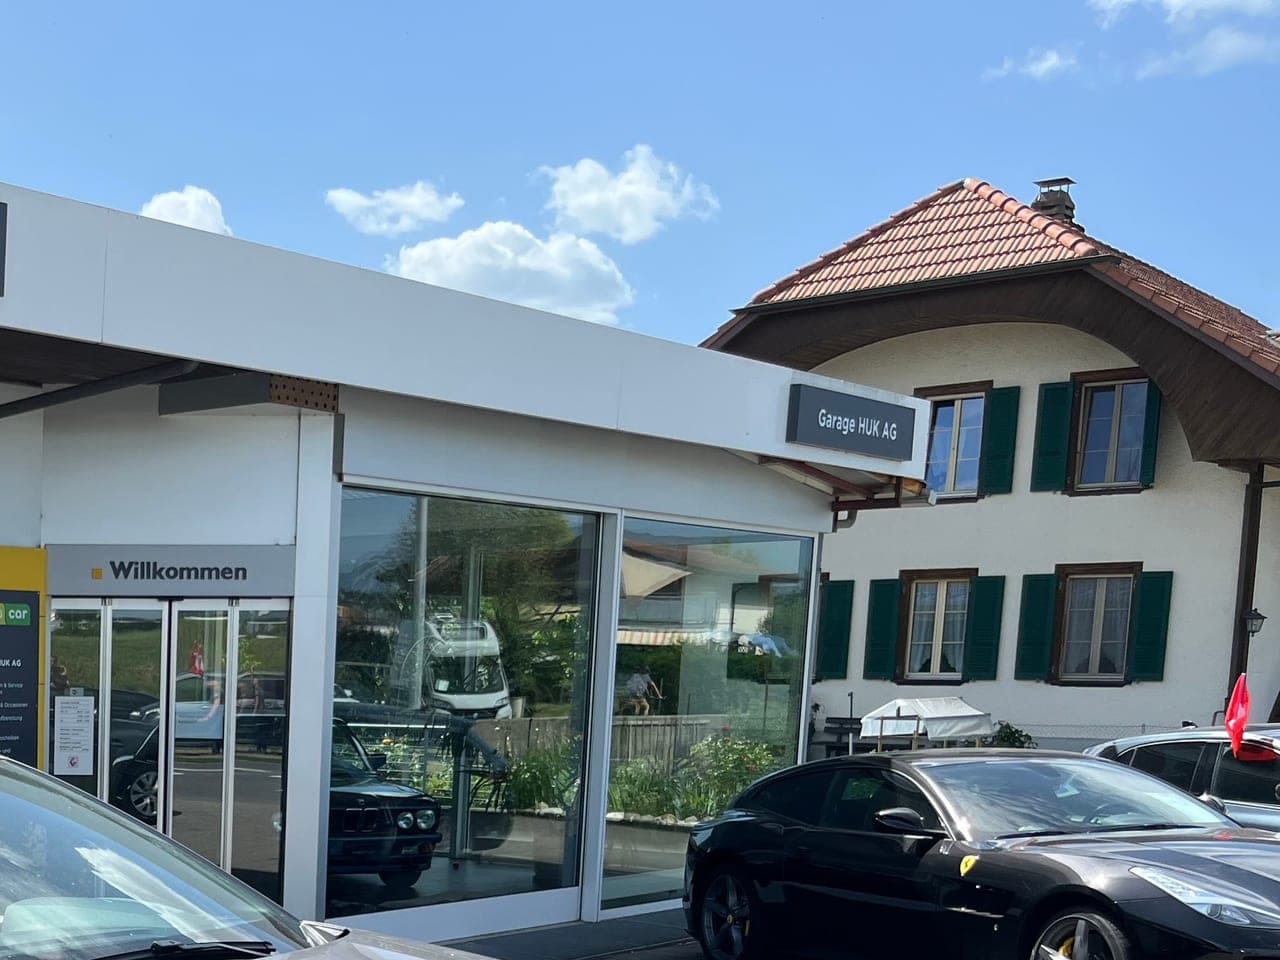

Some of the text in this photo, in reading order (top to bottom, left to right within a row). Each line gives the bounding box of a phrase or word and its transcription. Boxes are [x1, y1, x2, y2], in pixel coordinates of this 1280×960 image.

[818, 408, 897, 441] Garage HUK AG
[109, 560, 247, 580] Willkommen
[8, 609, 28, 619] car
[11, 659, 22, 667] AG
